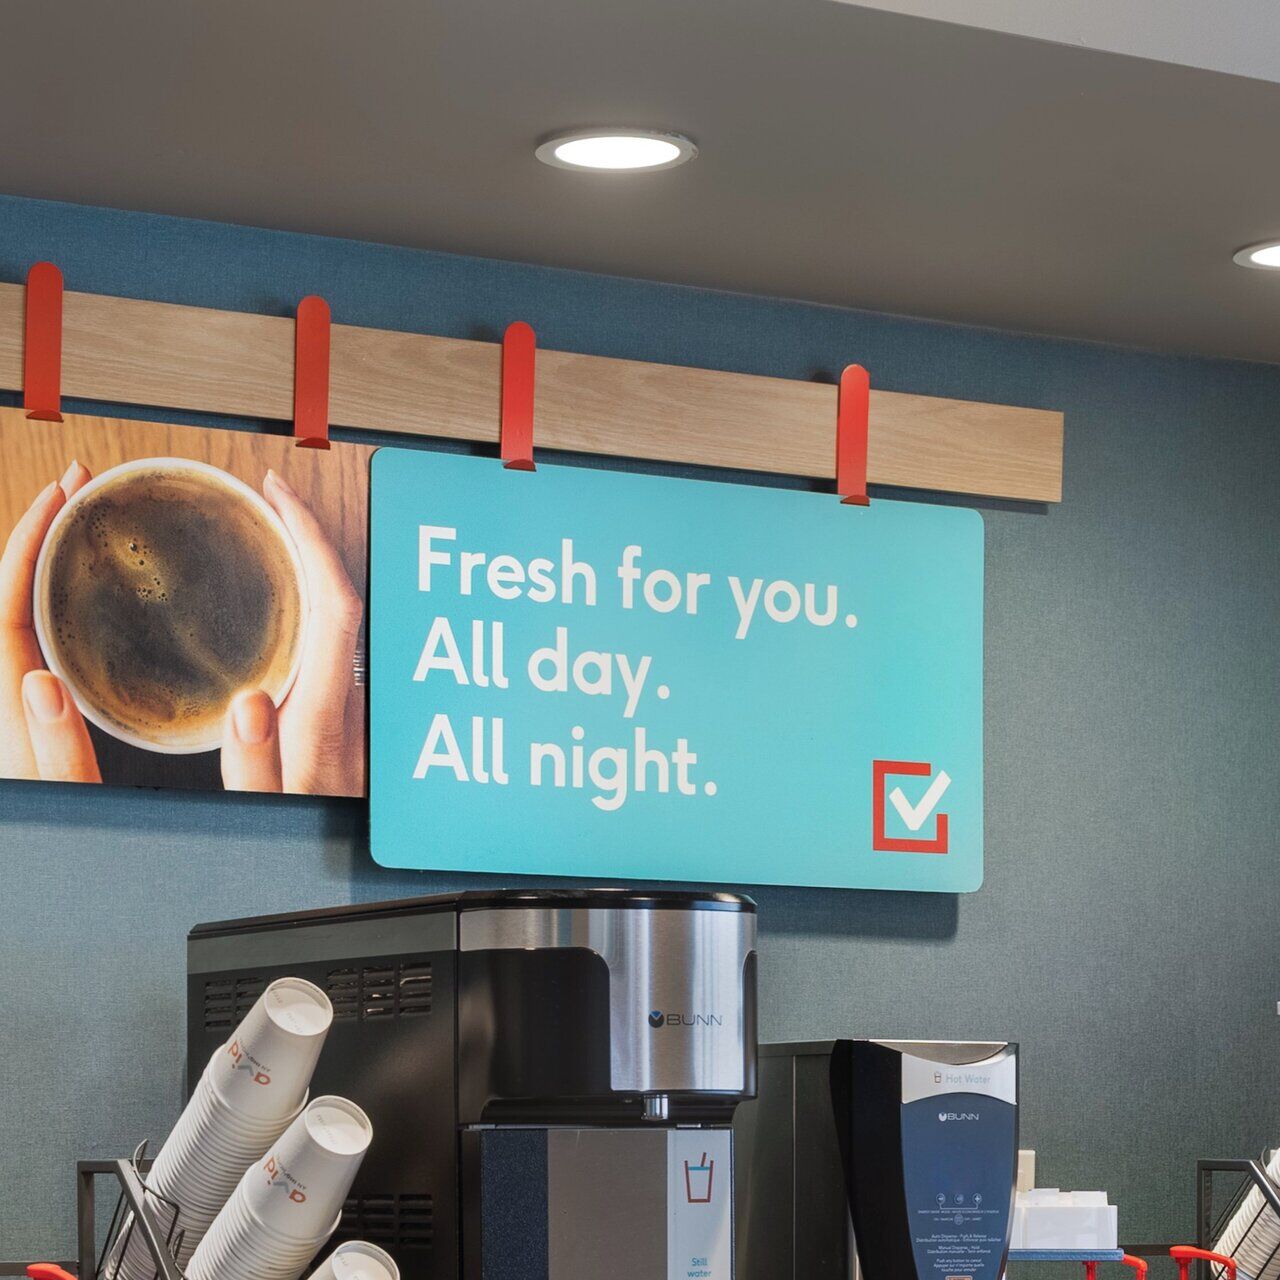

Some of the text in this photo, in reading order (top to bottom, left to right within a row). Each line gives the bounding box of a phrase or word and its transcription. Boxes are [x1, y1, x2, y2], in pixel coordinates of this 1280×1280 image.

[419, 524, 858, 639] Fresh for you.
[413, 617, 509, 688] All
[528, 627, 670, 718] day.
[413, 713, 718, 811] All night.
[666, 1013, 723, 1026] BUNN
[228, 1040, 271, 1086] avid
[945, 1074, 991, 1084] Hot Water
[947, 1113, 979, 1121] BUNN
[263, 1155, 306, 1203] avid
[687, 1270, 712, 1278] water
[691, 1258, 708, 1267] Still
